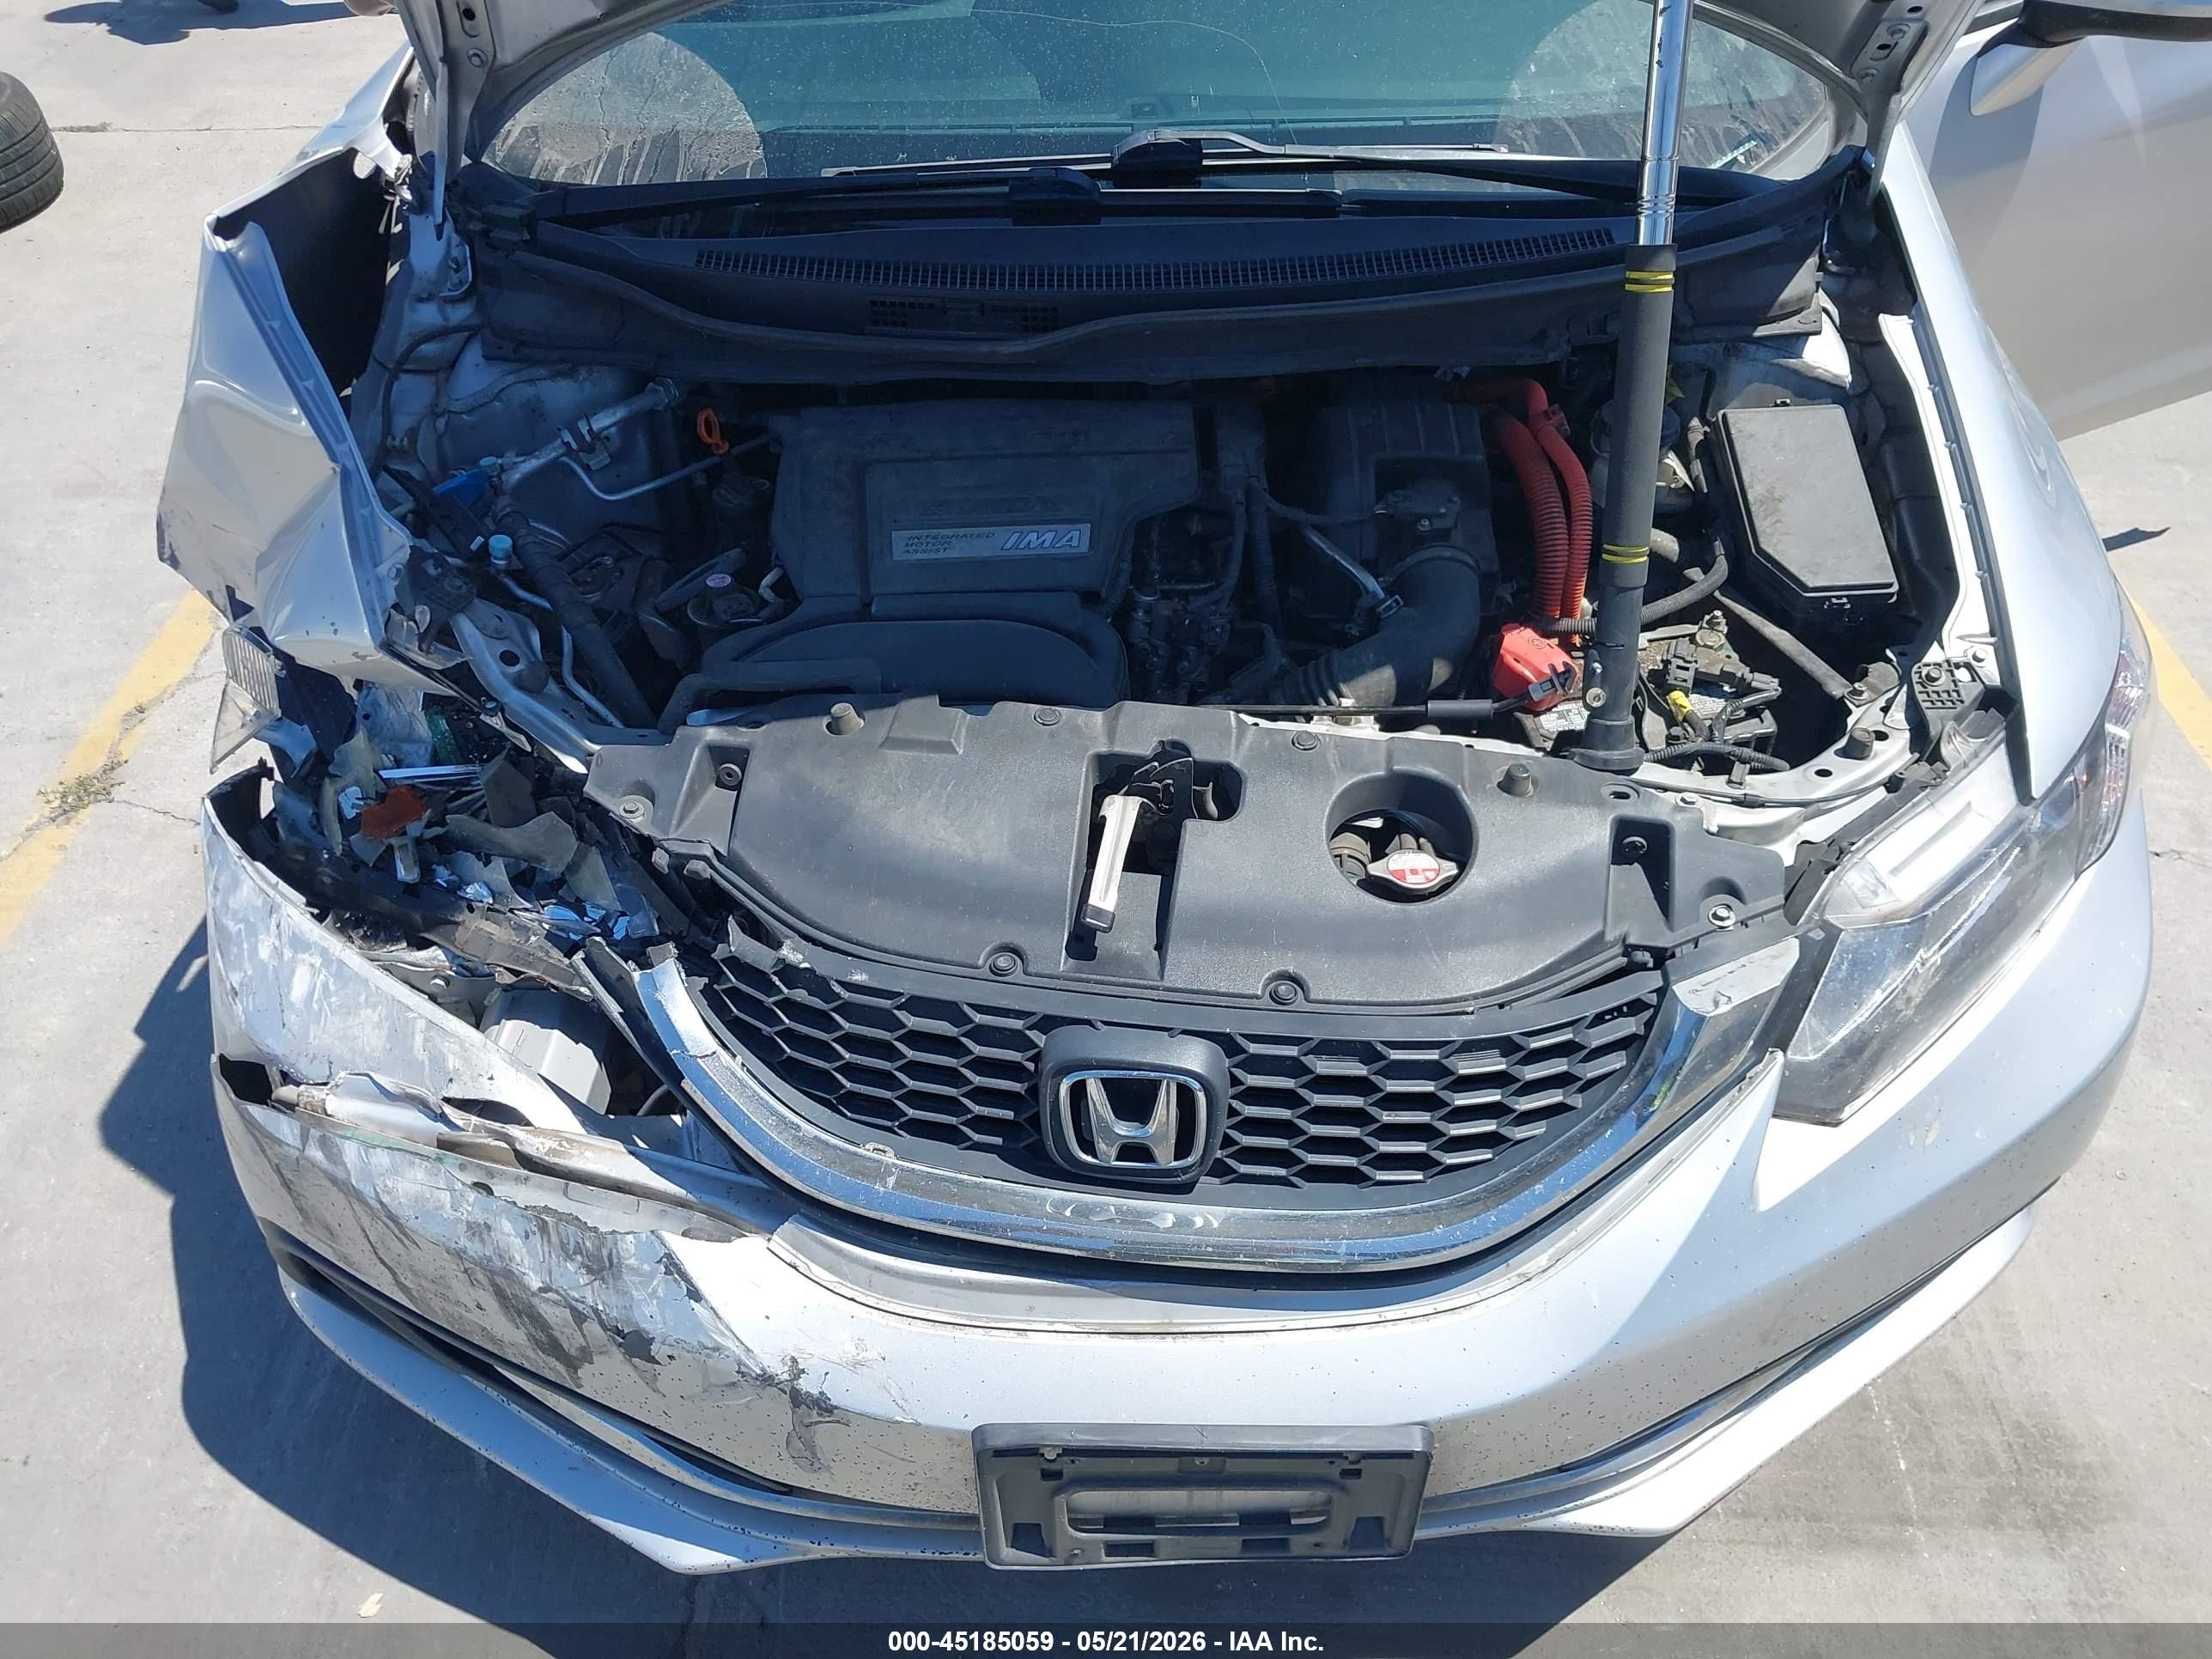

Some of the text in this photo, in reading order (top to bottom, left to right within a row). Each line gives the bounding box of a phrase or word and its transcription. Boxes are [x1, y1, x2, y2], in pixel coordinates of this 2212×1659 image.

[907, 532, 996, 542] INTEGRATED
[1000, 529, 1082, 551] IMA
[904, 539, 951, 549] MOTOR
[902, 547, 948, 556] ASSIST
